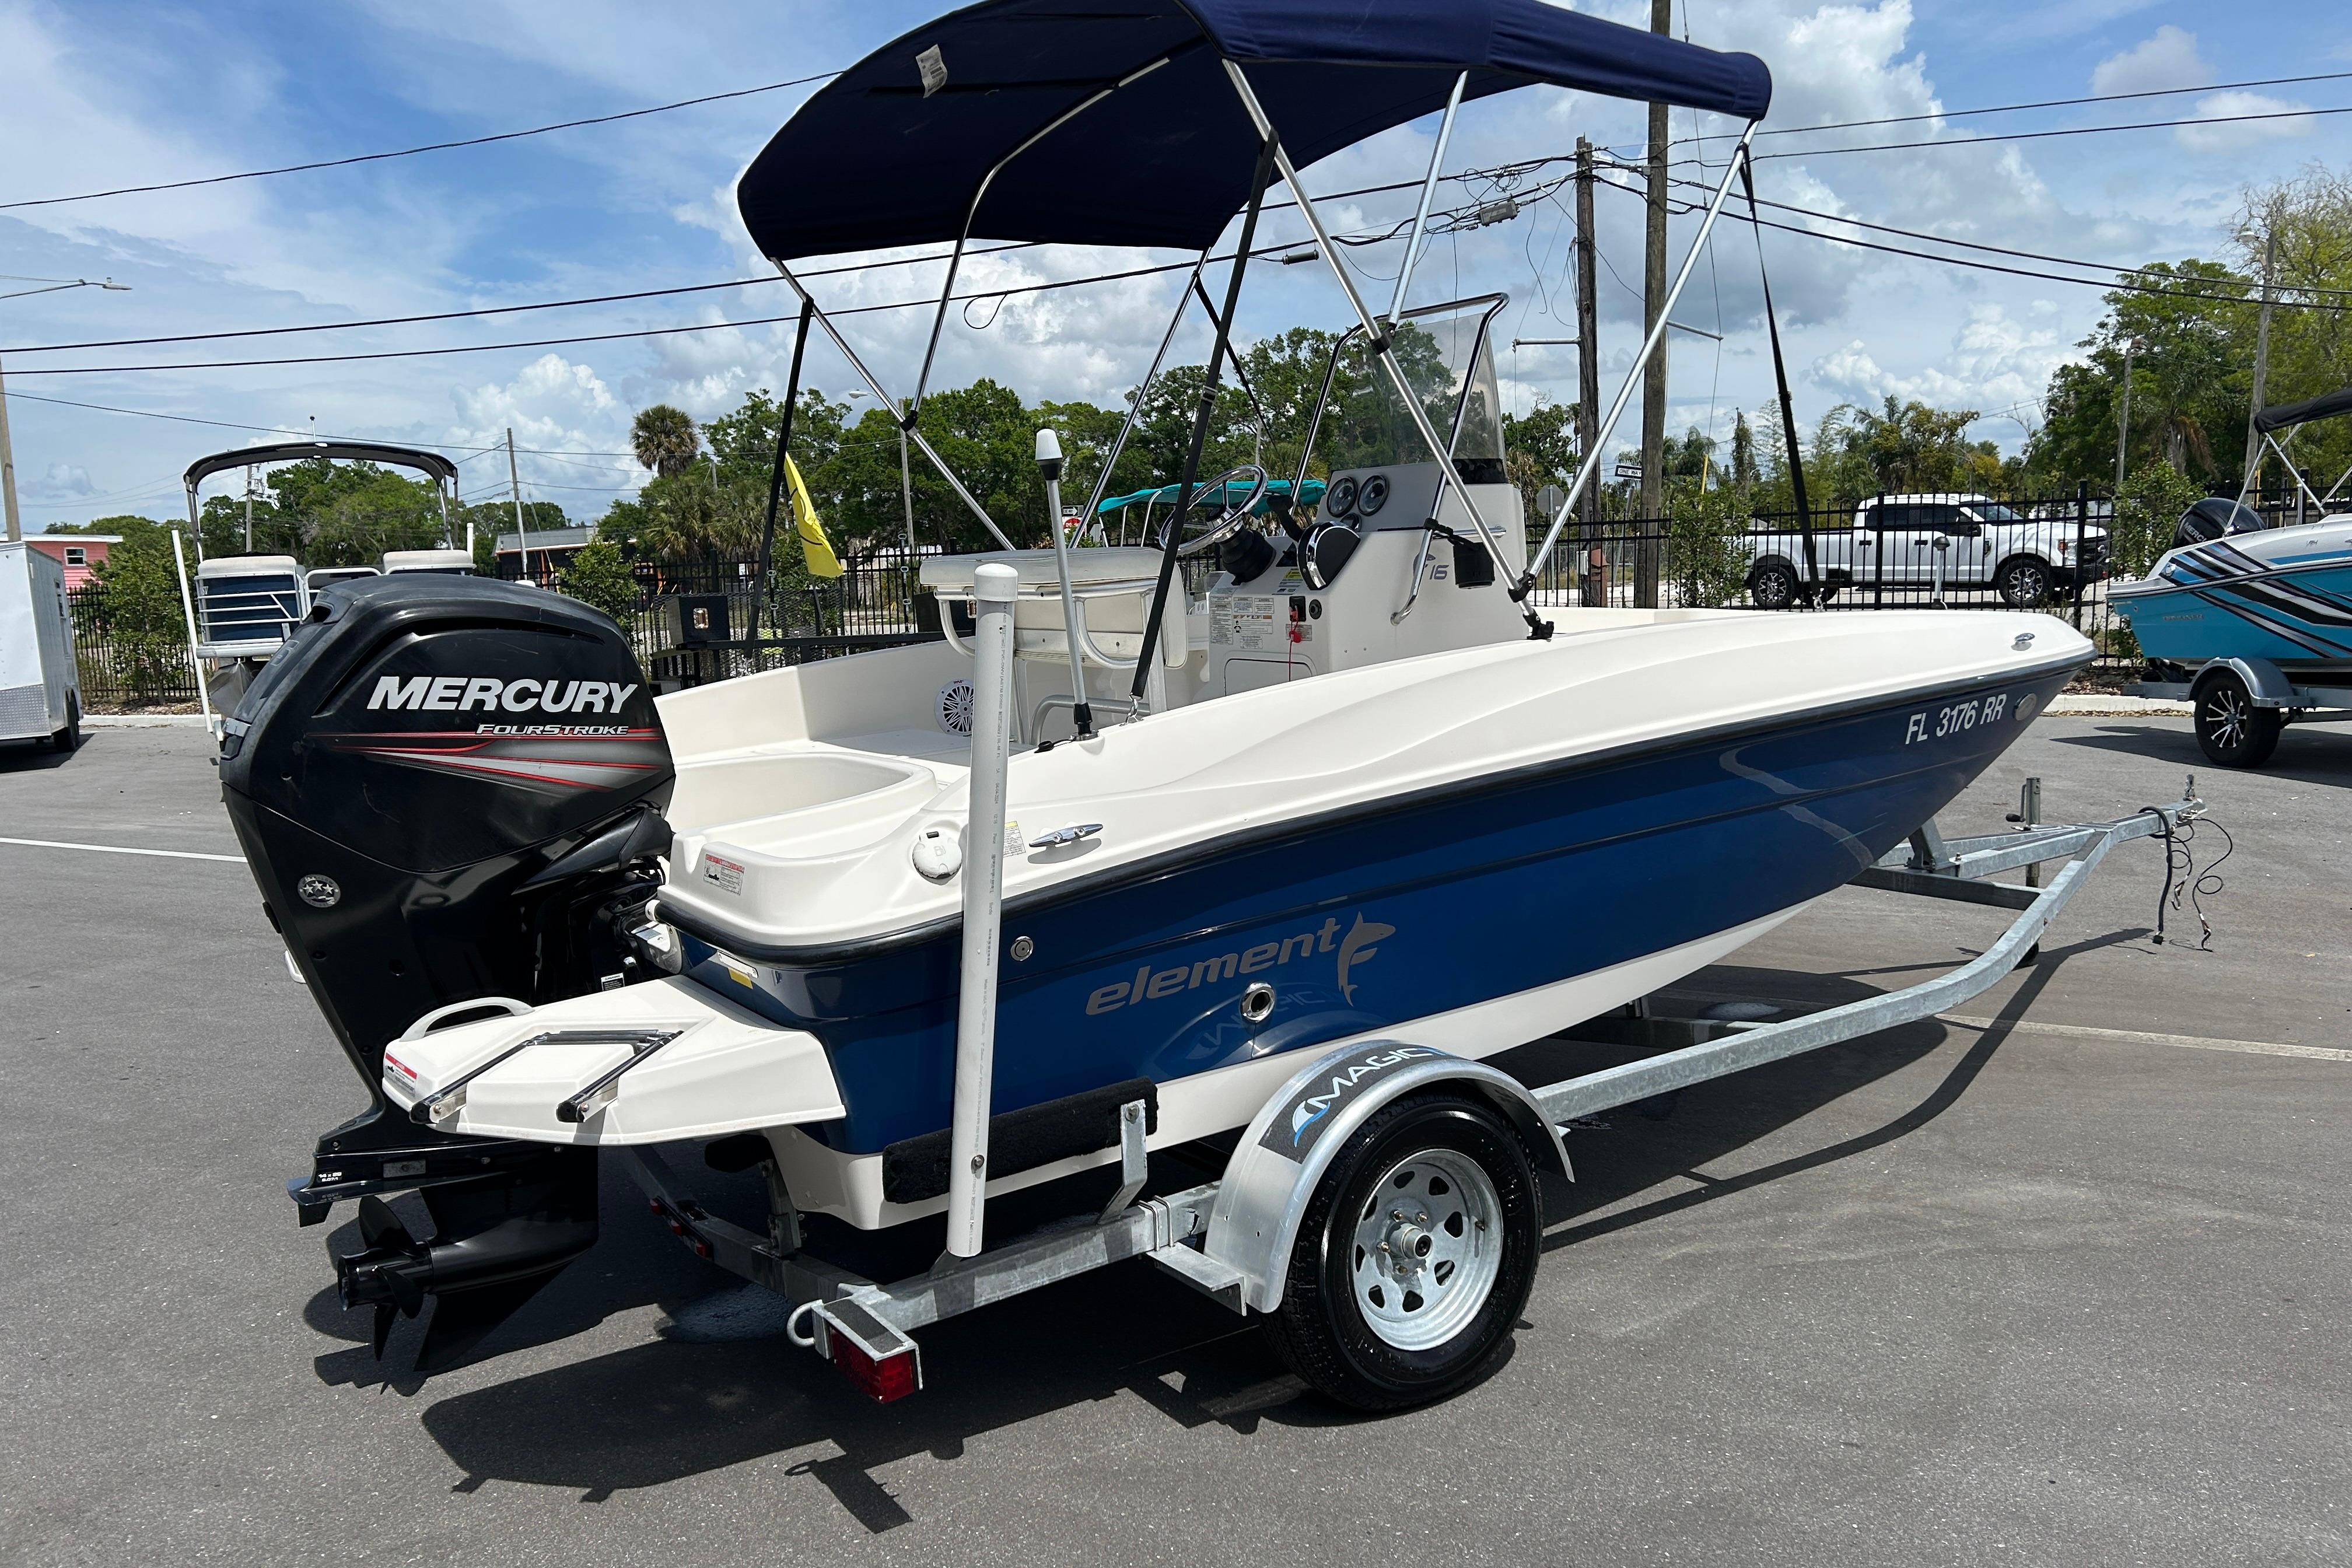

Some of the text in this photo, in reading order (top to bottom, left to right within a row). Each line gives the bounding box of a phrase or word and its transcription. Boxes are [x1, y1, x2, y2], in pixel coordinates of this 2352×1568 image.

[1429, 564, 1450, 580] 16
[366, 676, 638, 713] MERCURY
[1905, 694, 2007, 745] FL 3176 RR
[1085, 917, 1342, 1016] element
[1307, 1048, 1433, 1110] MAGIC
